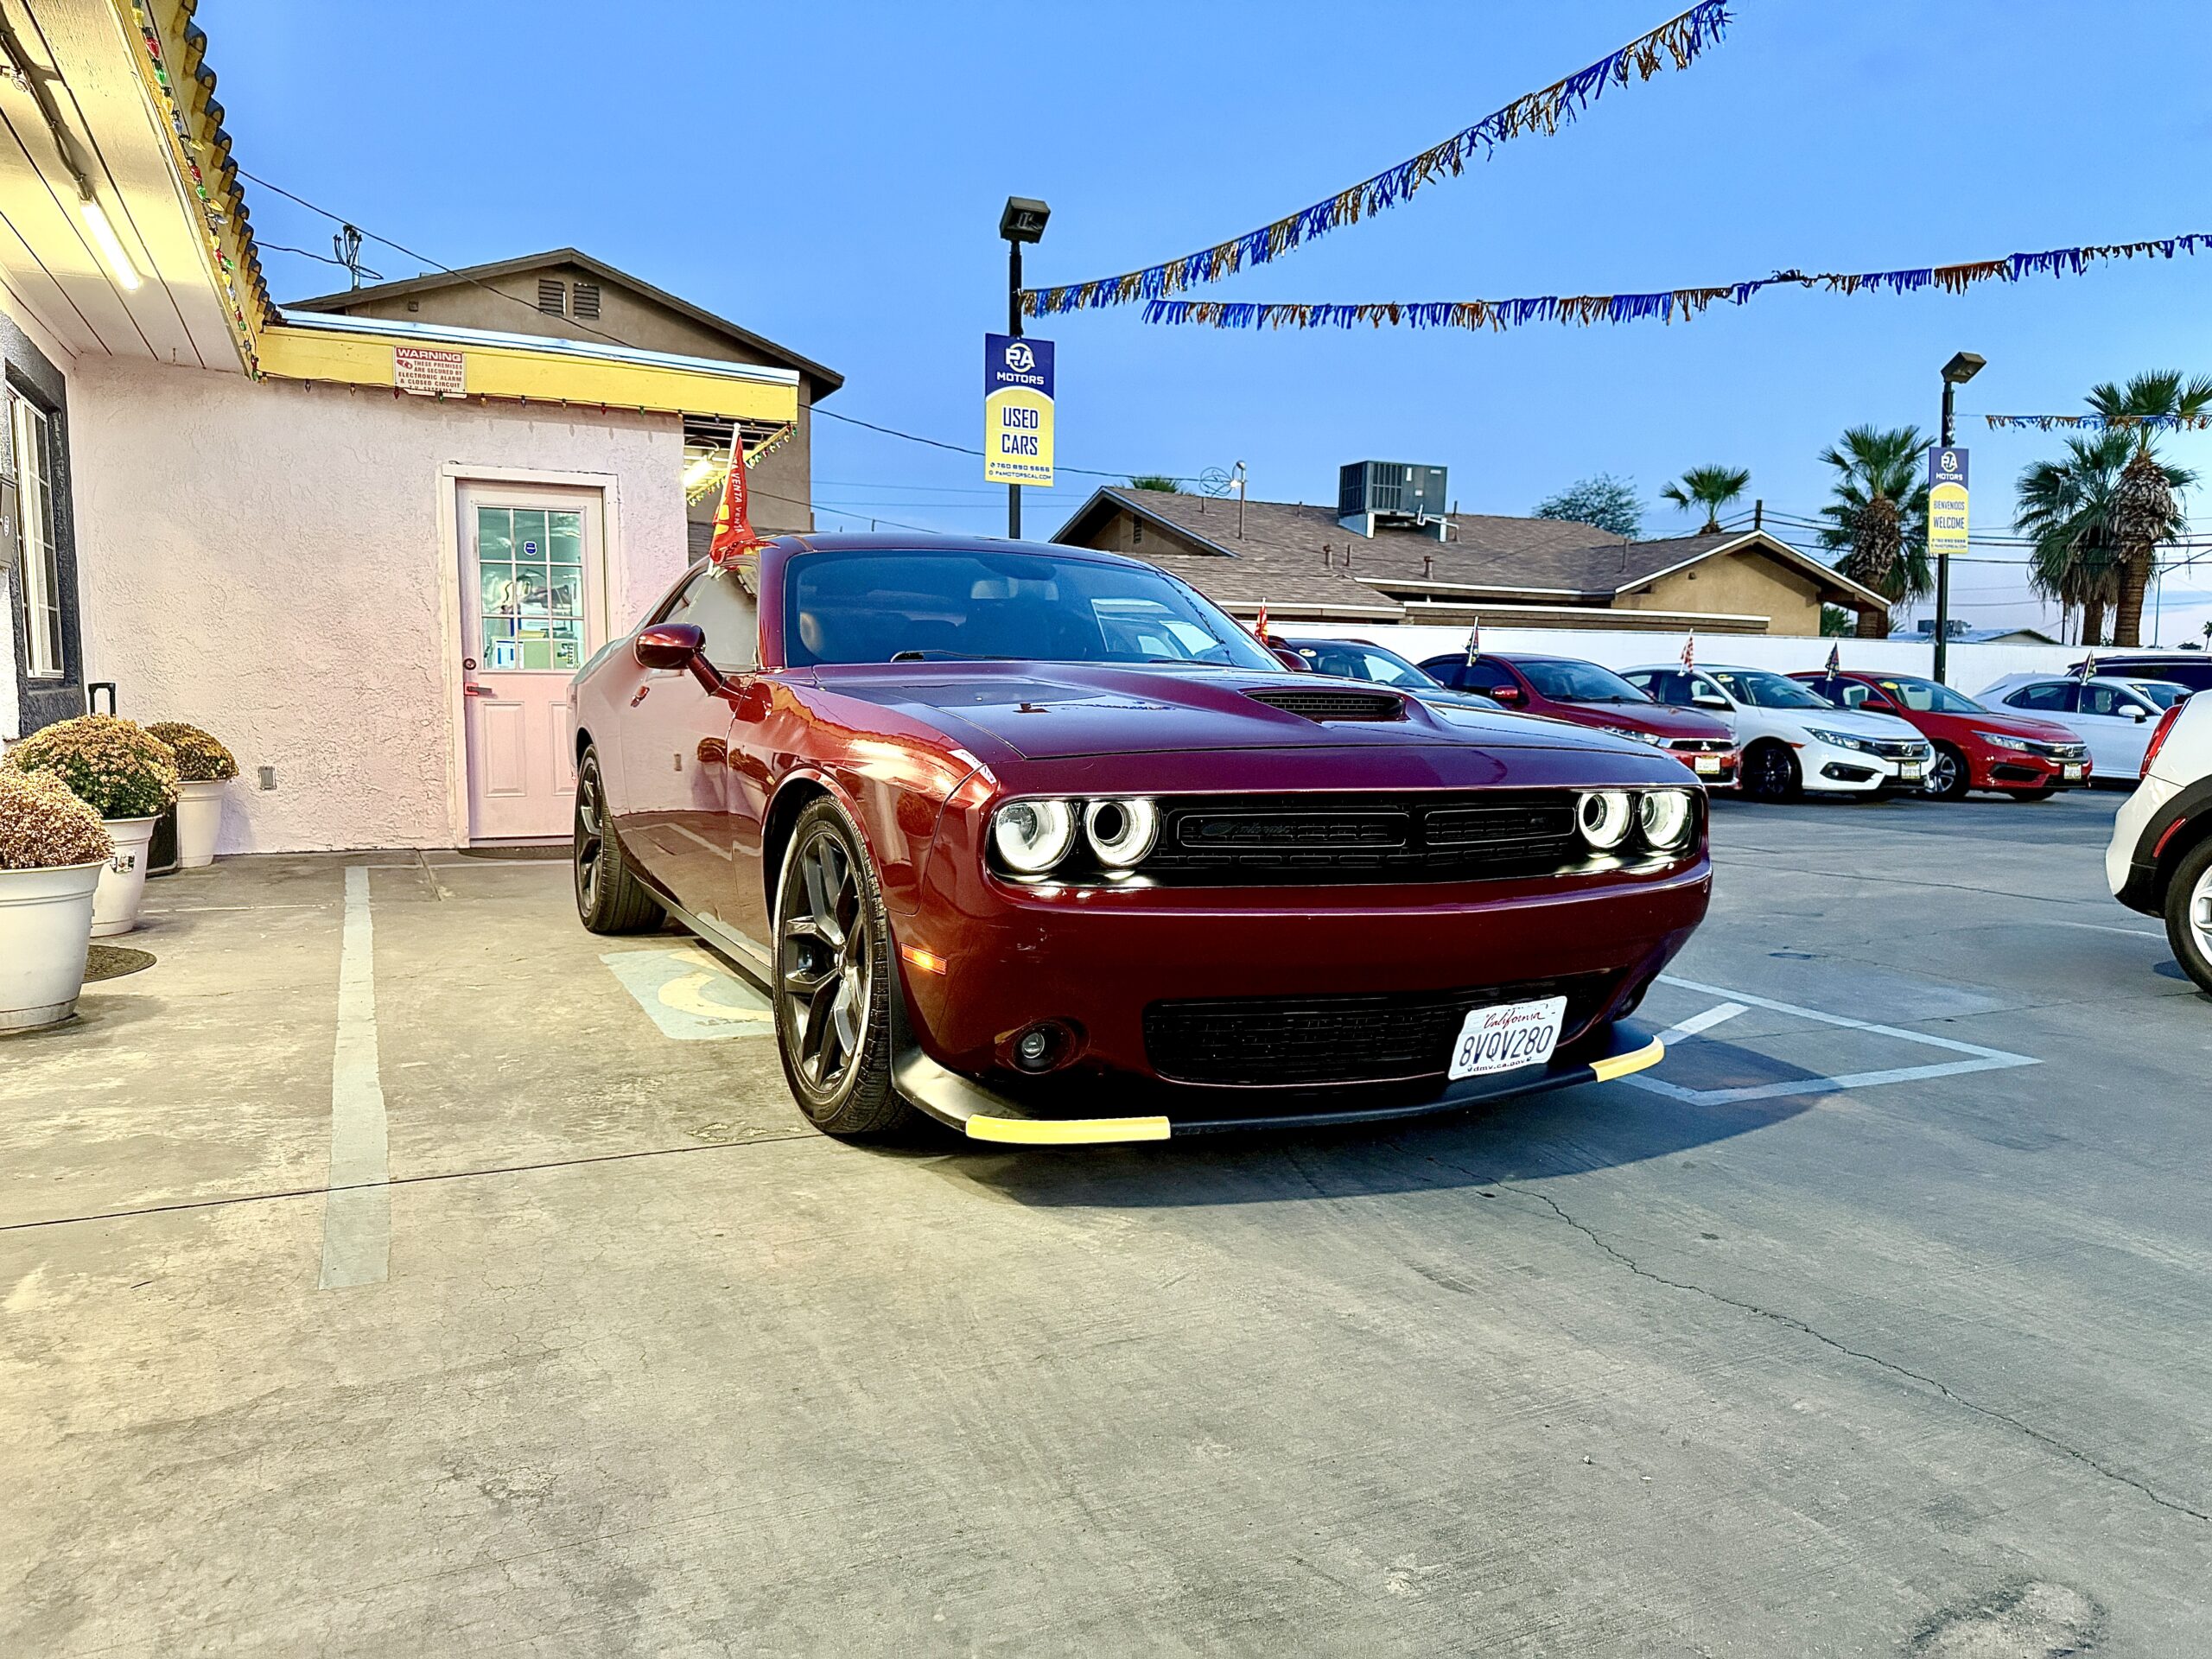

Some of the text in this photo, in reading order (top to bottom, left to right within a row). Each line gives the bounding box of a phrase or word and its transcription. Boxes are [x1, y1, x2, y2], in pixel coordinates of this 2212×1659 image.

[398, 349, 461, 361] WARNING
[398, 372, 437, 380] ELECTRONIC
[996, 372, 1044, 385] MOTORS
[1003, 407, 1039, 429] USED
[1001, 434, 1038, 455] CARS
[1936, 472, 1963, 480] MOTORS
[731, 473, 743, 503] VENTA
[1933, 516, 1965, 529] WELCOME
[1484, 1009, 1546, 1030] California
[1459, 1025, 1554, 1067] 8VQV280
